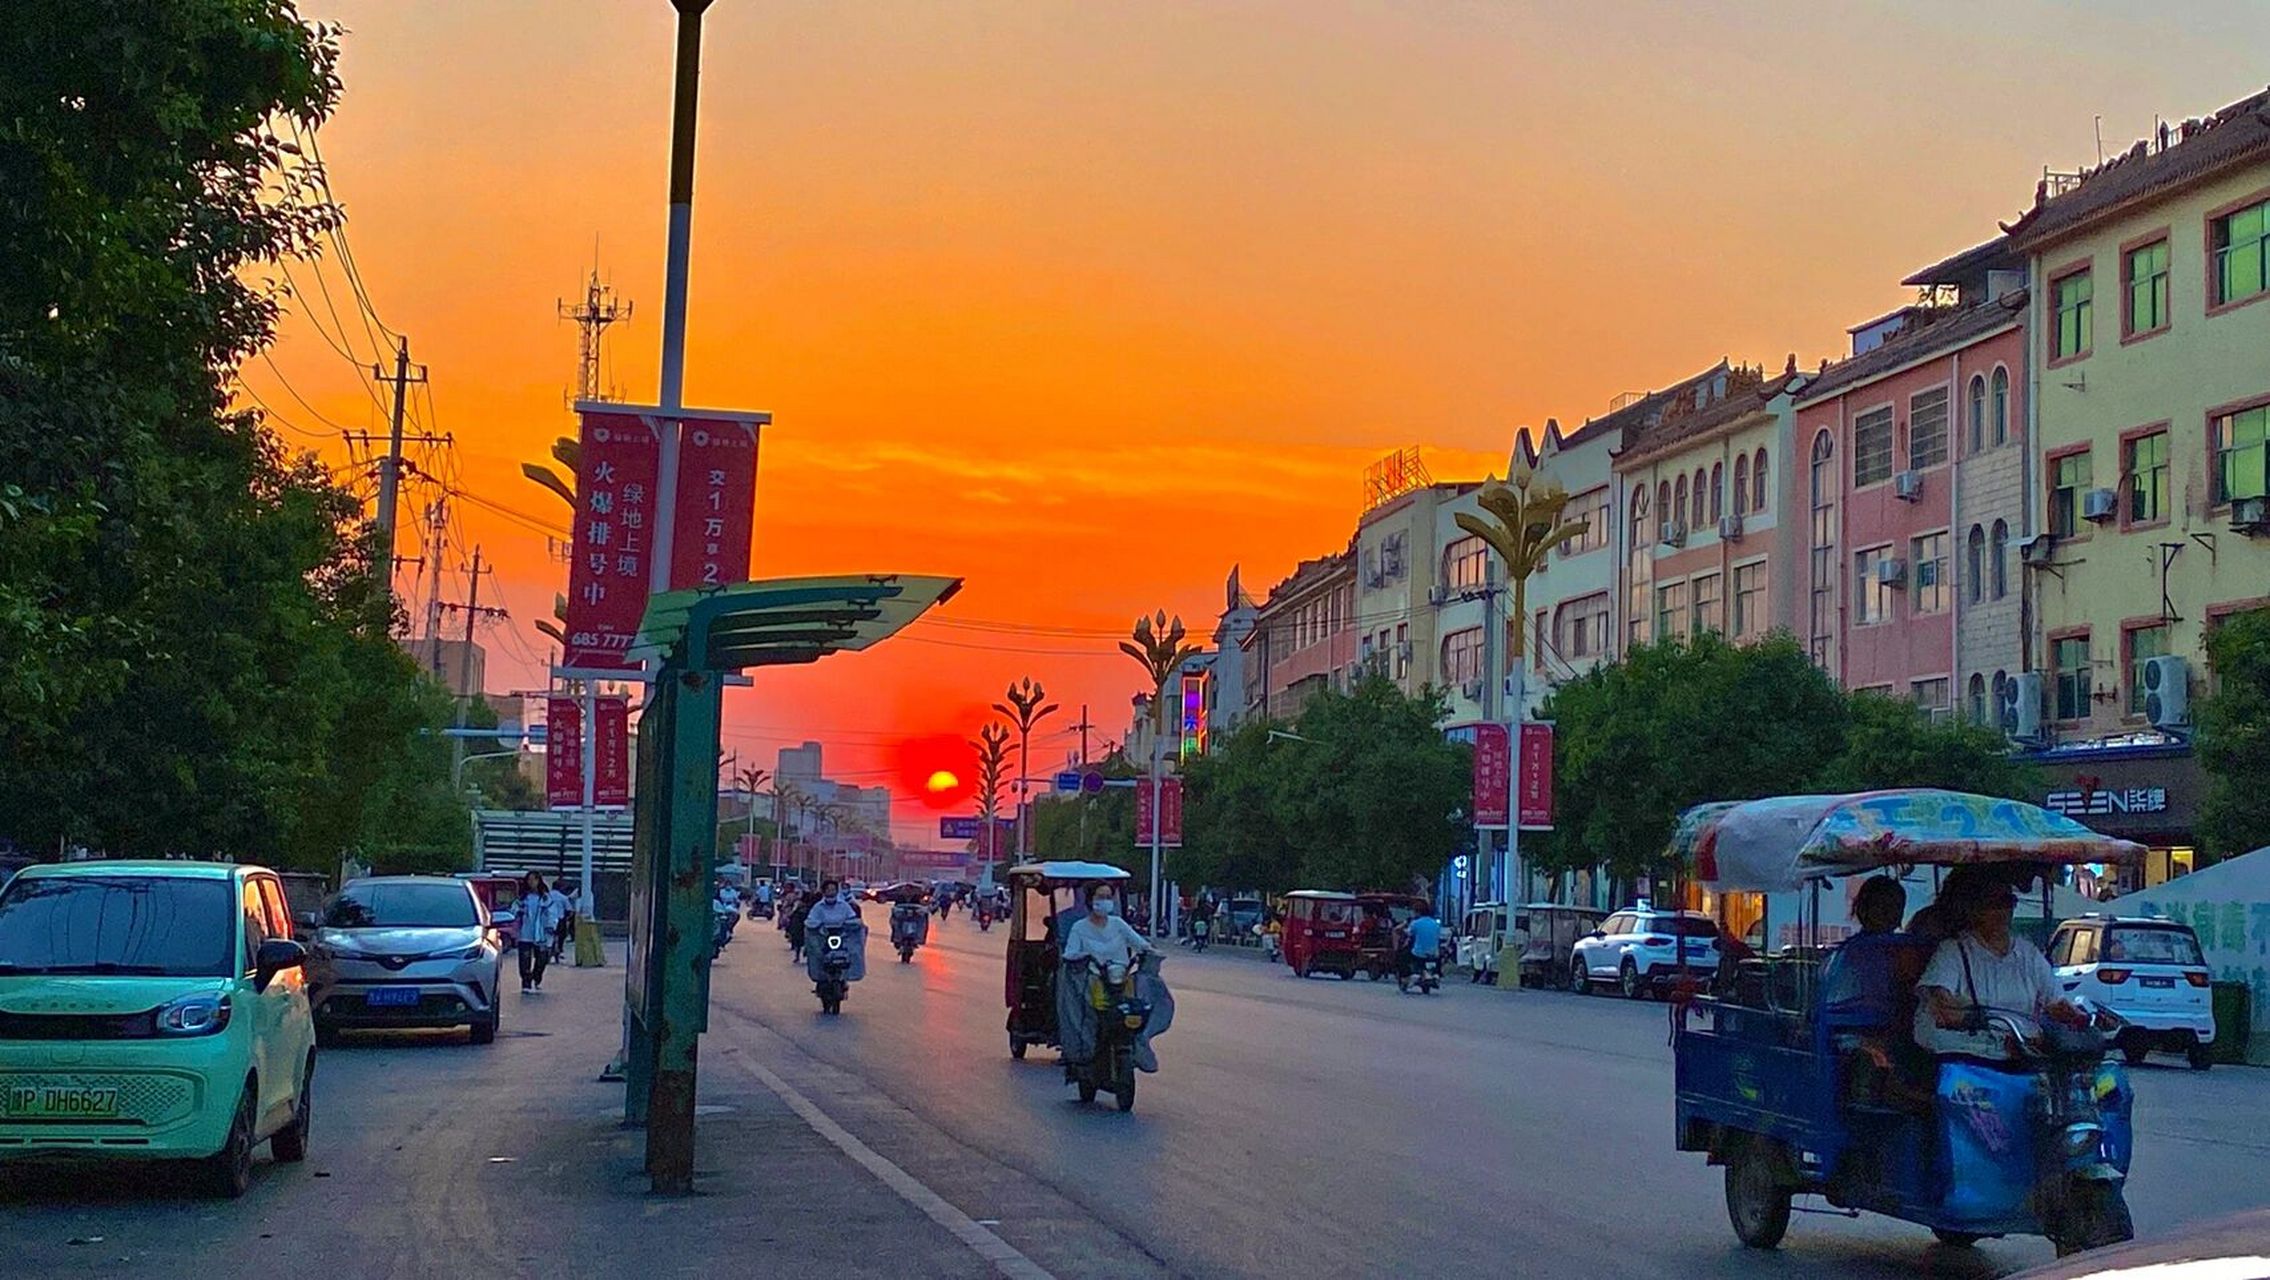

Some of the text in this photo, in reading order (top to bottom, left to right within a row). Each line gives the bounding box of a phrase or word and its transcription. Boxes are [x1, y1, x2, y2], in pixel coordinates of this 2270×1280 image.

[584, 461, 615, 606] 火爆排号中
[616, 483, 645, 577] 绿地上境
[571, 632, 599, 646] 685
[46, 1089, 116, 1112] DH6627
